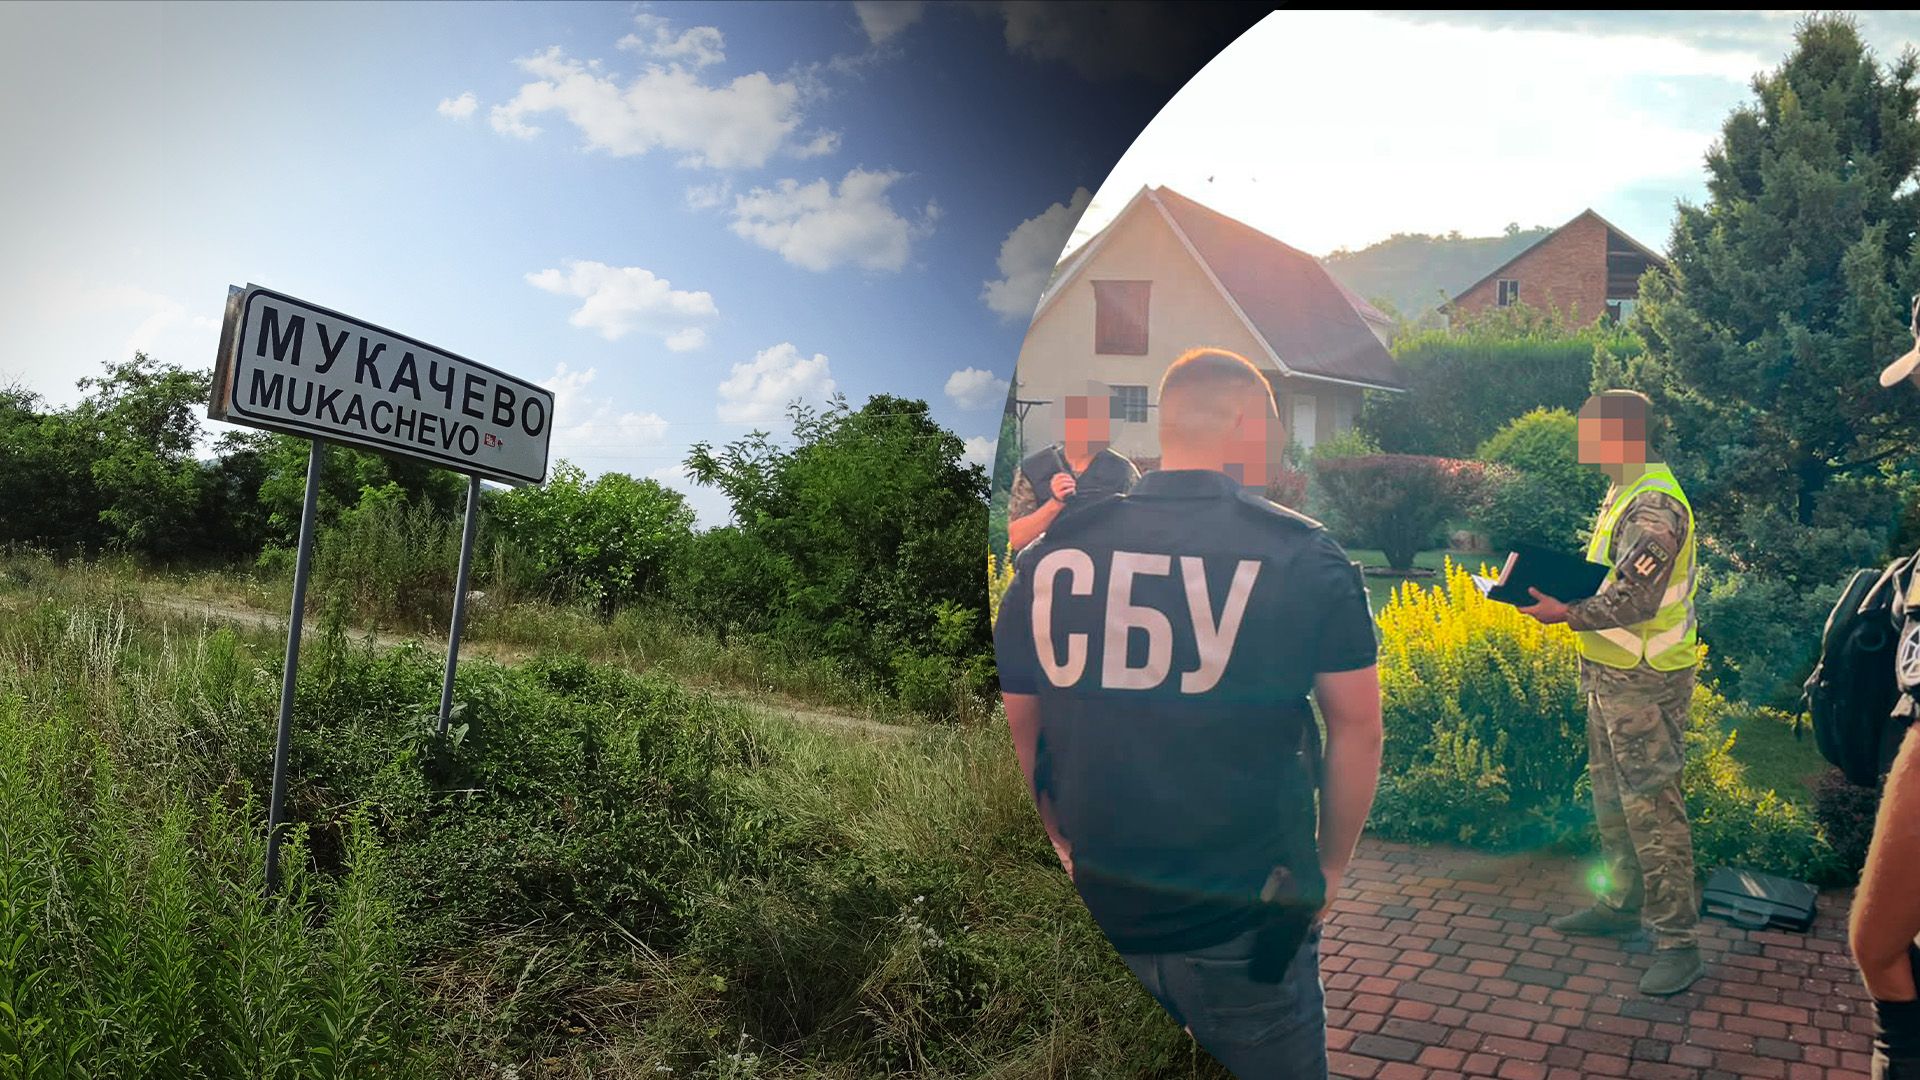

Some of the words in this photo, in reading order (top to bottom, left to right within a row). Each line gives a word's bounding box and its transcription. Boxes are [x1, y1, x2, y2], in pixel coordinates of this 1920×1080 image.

[249, 368, 479, 456] MUKACHEVO
[256, 306, 545, 437] МУКАЧЕВО
[1032, 548, 1262, 694] СБУ
